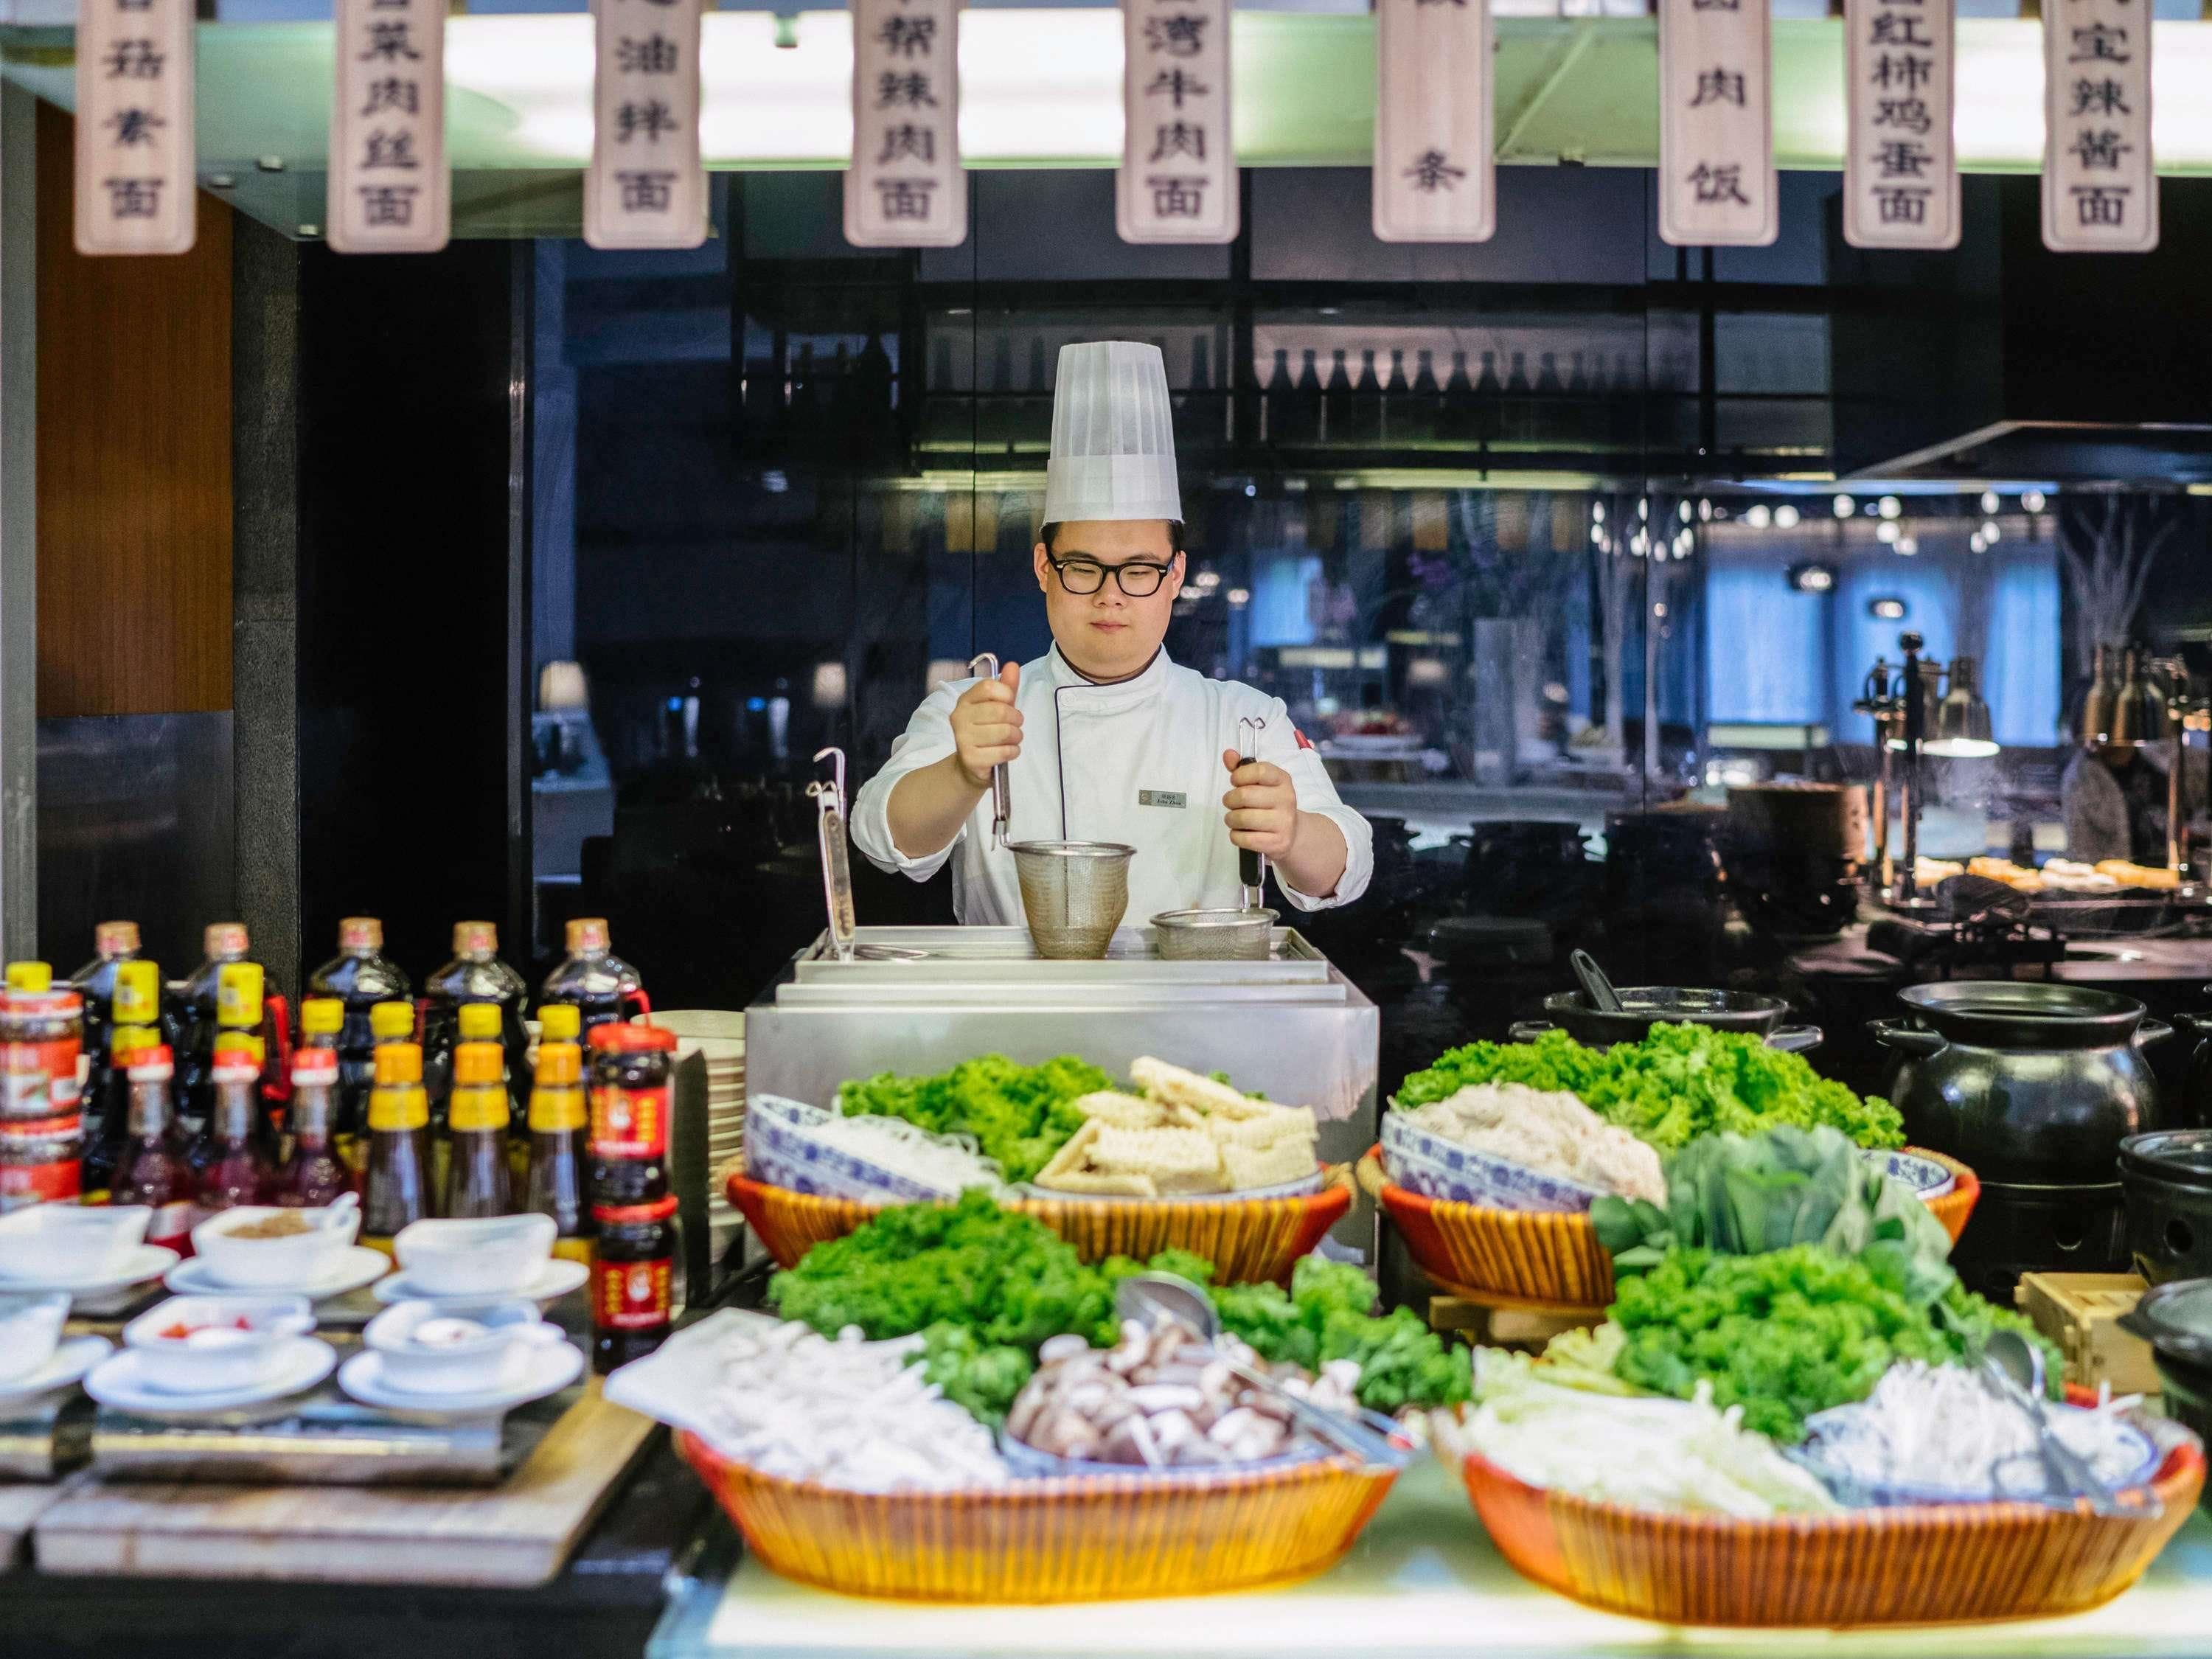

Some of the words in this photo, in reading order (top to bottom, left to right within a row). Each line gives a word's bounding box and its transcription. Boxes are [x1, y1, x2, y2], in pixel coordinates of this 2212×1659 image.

[101, 0, 166, 219] 菇素面
[358, 0, 422, 226] 菜肉丝面
[616, 0, 680, 212] 油拌面
[874, 0, 938, 220] 帮辣肉面
[1687, 0, 1750, 205] 肉饭
[1870, 0, 1933, 223] 红柿鸡蛋面
[2067, 0, 2132, 225] 宝辣酱面
